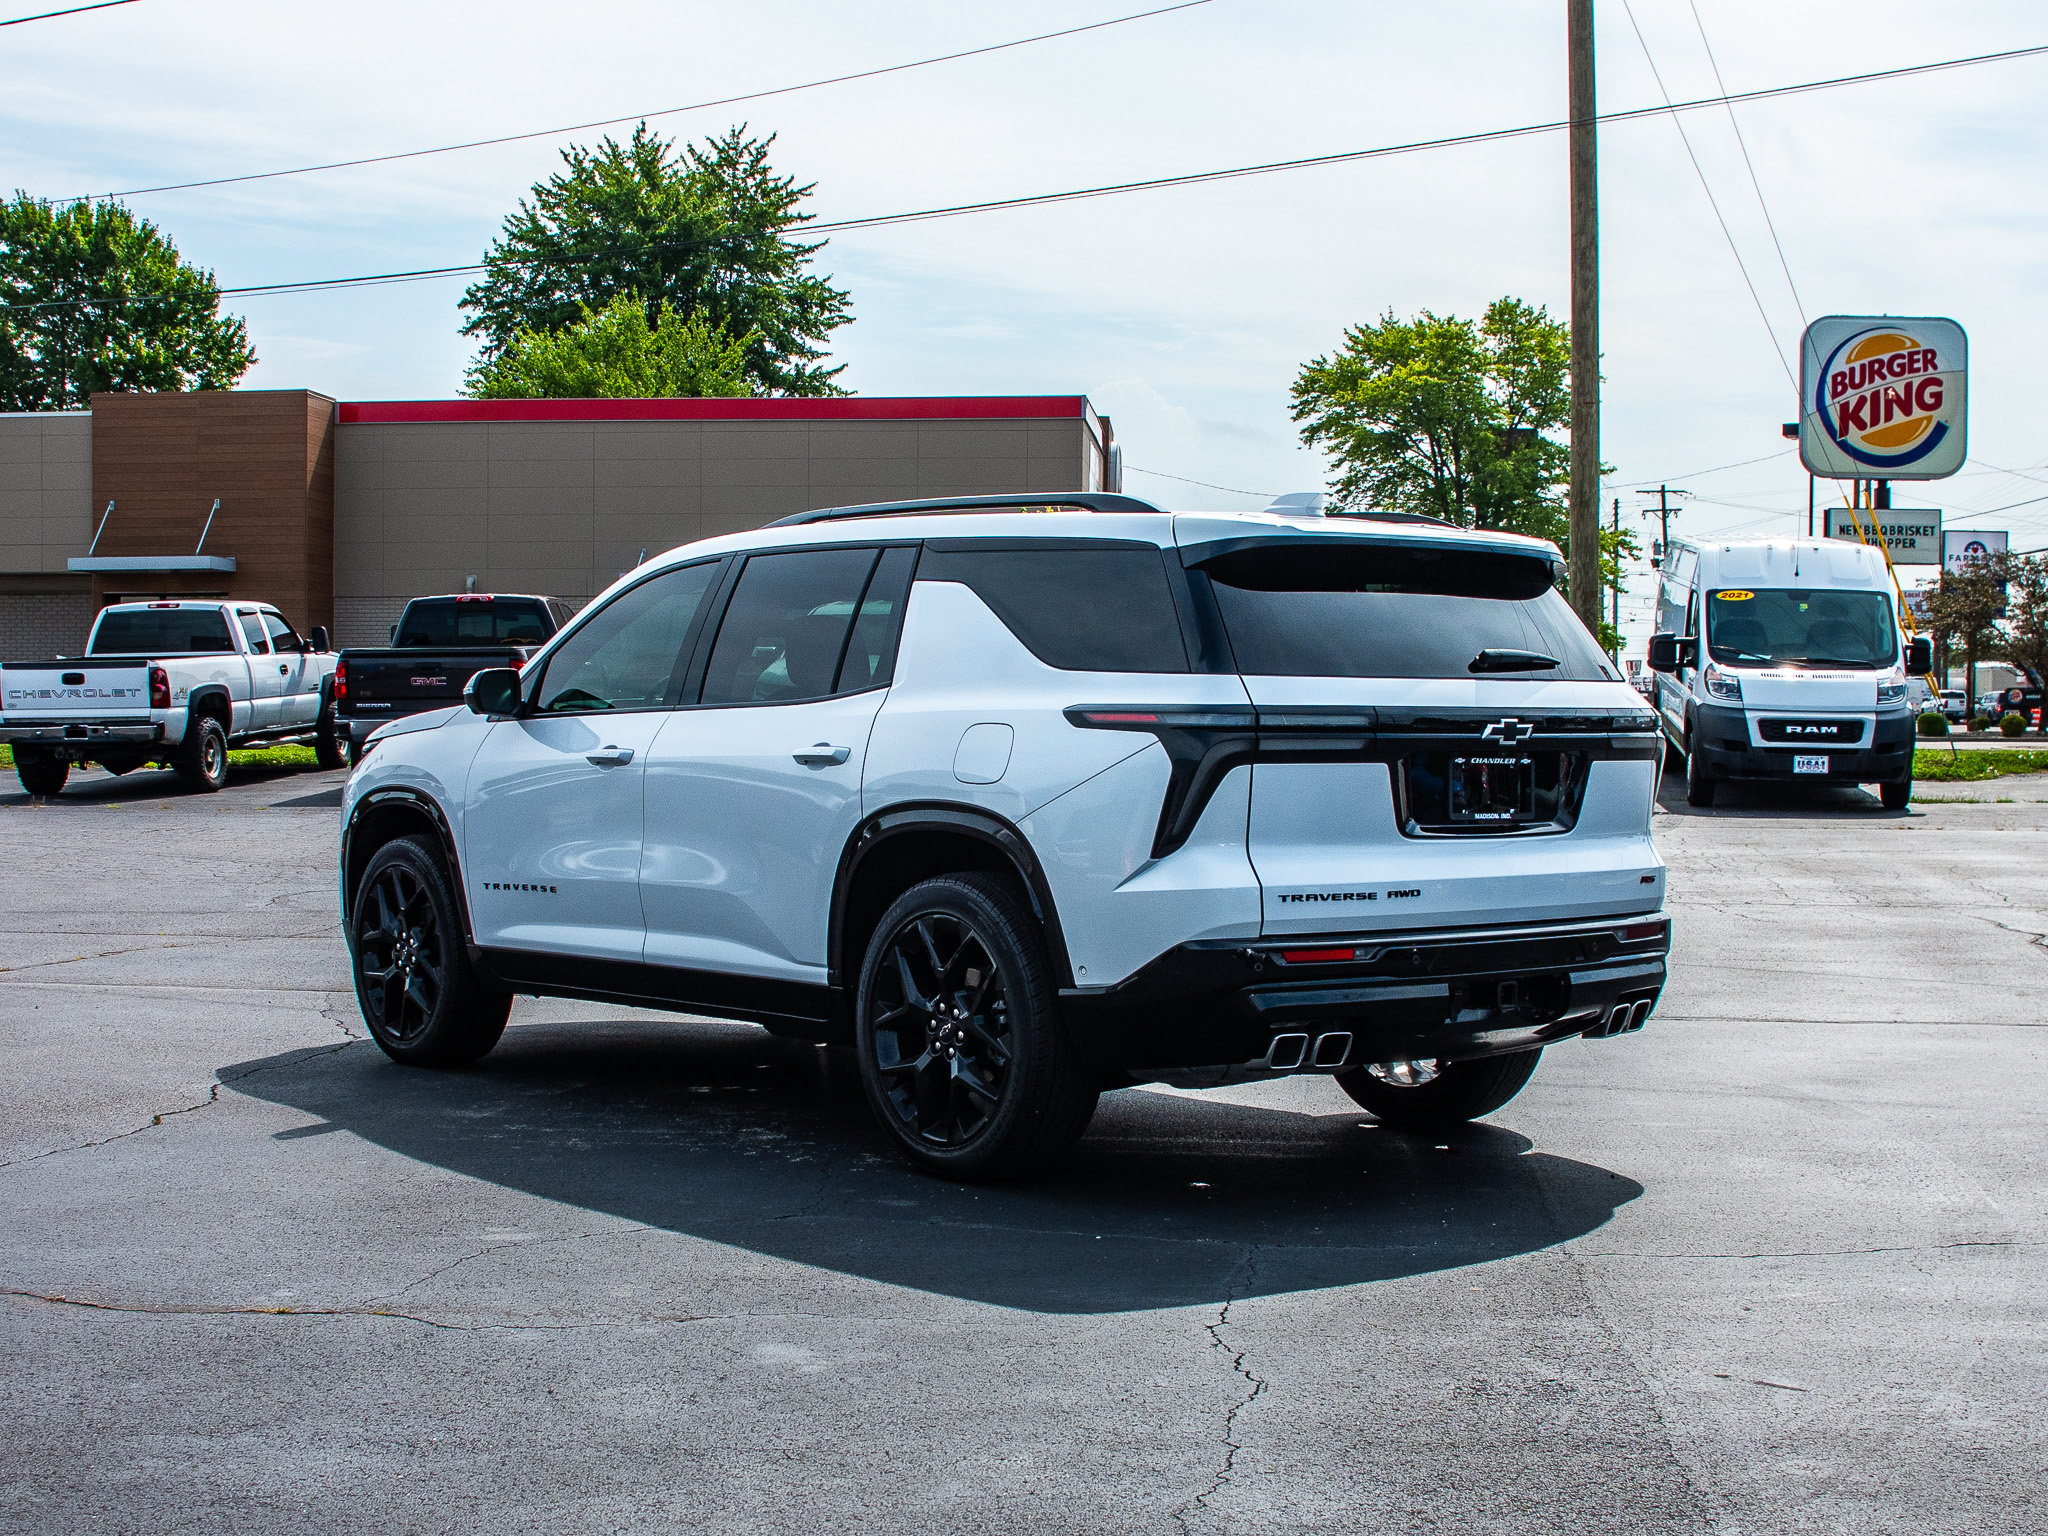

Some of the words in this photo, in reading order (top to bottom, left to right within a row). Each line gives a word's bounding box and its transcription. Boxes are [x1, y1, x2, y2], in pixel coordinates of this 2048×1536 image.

[1831, 348, 1939, 400] BURGER
[1838, 376, 1944, 439] KING
[410, 677, 447, 686] GMC
[9, 688, 142, 699] CHEVROLET
[1785, 726, 1838, 734] RAM
[1797, 760, 1826, 770] USA1
[1640, 875, 1656, 884] RS
[482, 882, 558, 894] TRAVERSE
[1278, 892, 1378, 903] TRAVERSE
[1387, 889, 1421, 899] AWD
